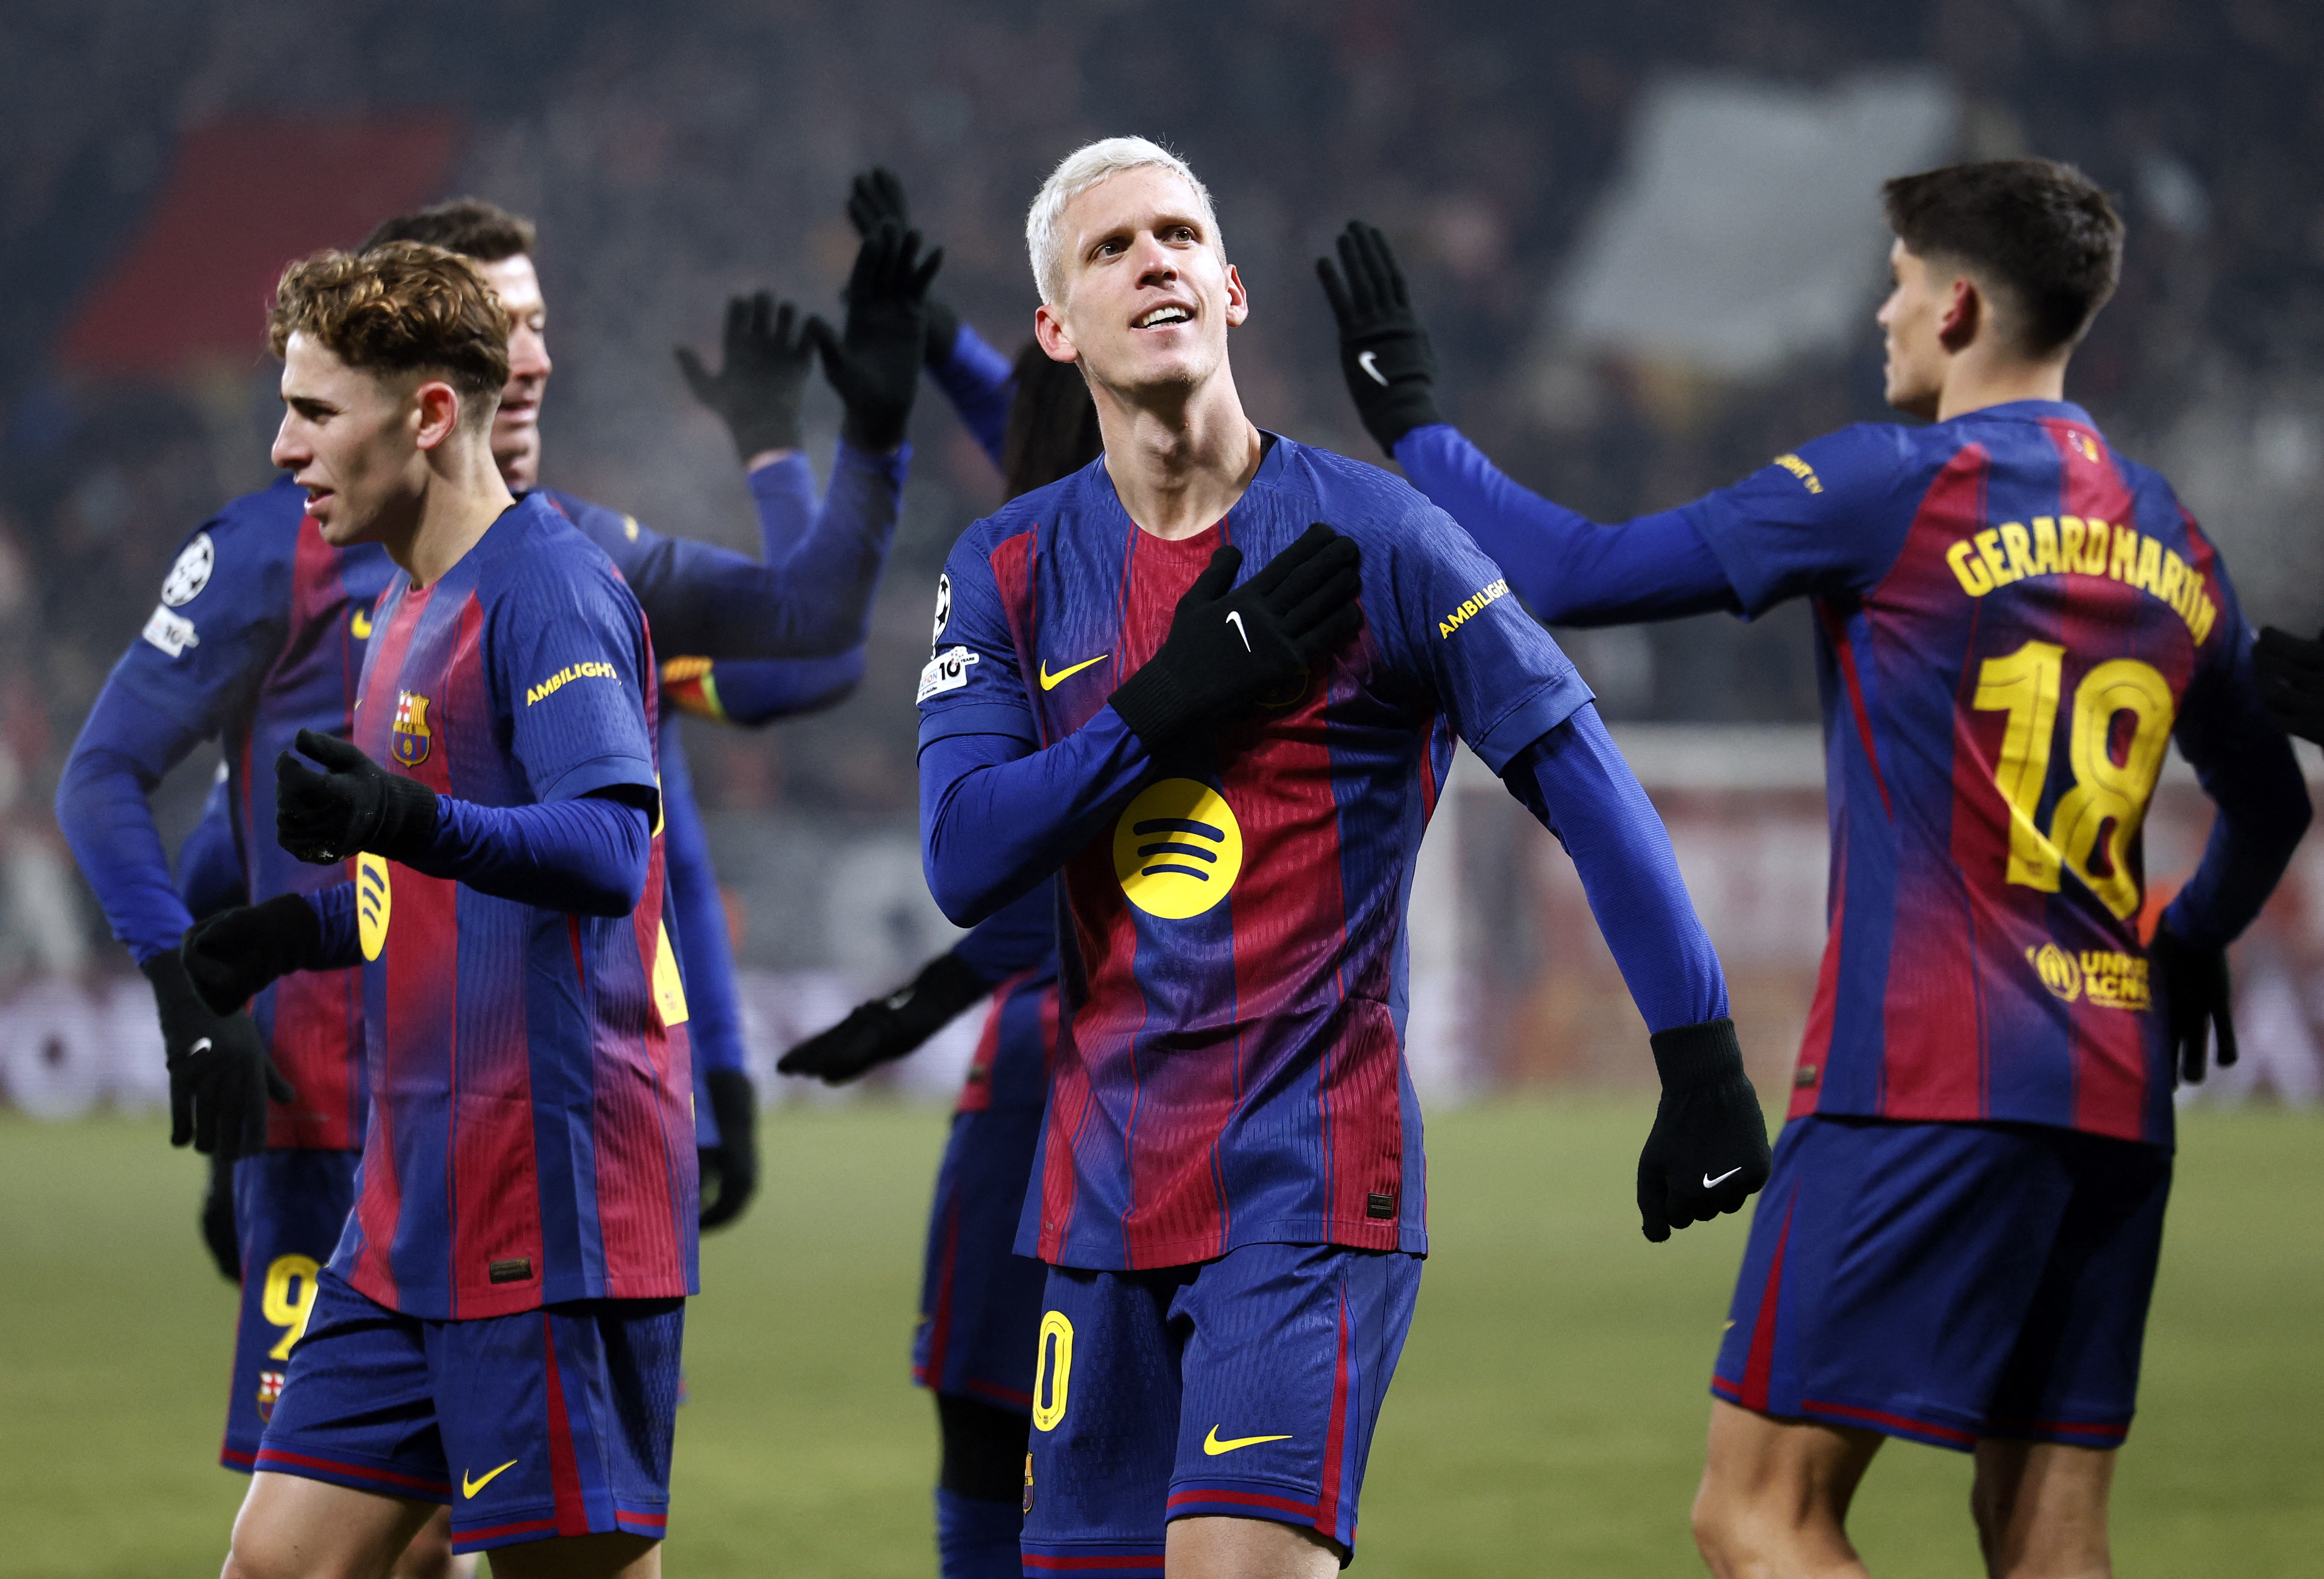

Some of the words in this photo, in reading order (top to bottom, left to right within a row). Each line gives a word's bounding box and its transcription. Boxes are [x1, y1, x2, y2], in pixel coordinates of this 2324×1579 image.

[939, 660, 960, 680] 10
[1973, 640, 2175, 920] 18
[262, 1253, 320, 1361] 9
[1033, 1311, 1073, 1431] 0
